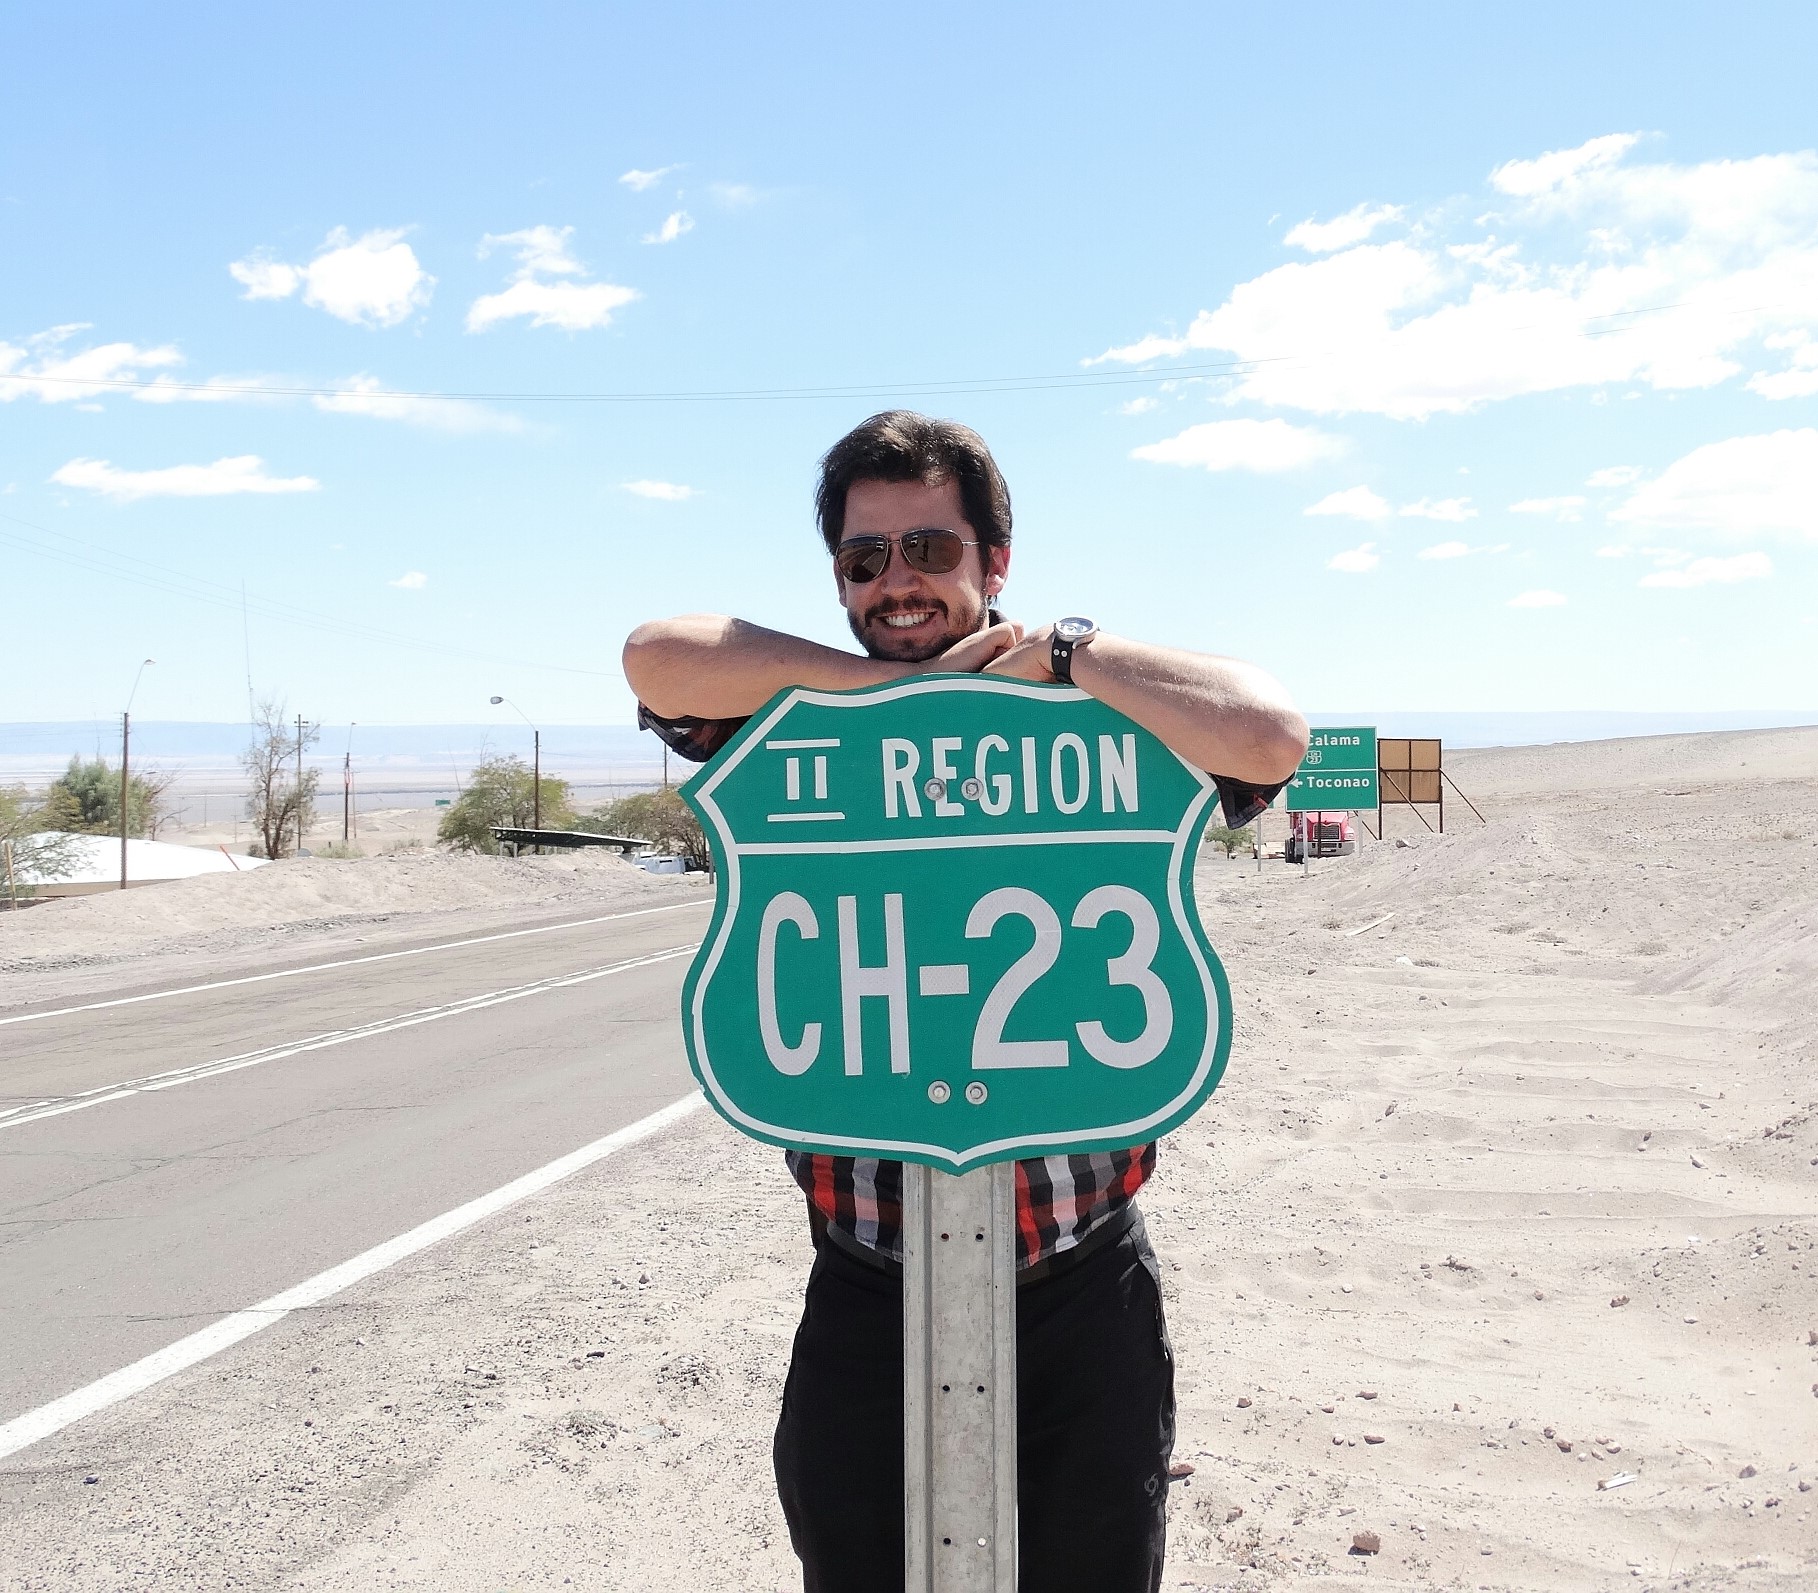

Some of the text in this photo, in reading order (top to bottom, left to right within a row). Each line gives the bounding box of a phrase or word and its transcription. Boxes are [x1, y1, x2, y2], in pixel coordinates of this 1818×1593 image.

[766, 733, 1138, 821] II REGION
[1306, 776, 1370, 788] Toconao
[757, 885, 1173, 1076] CH-23
